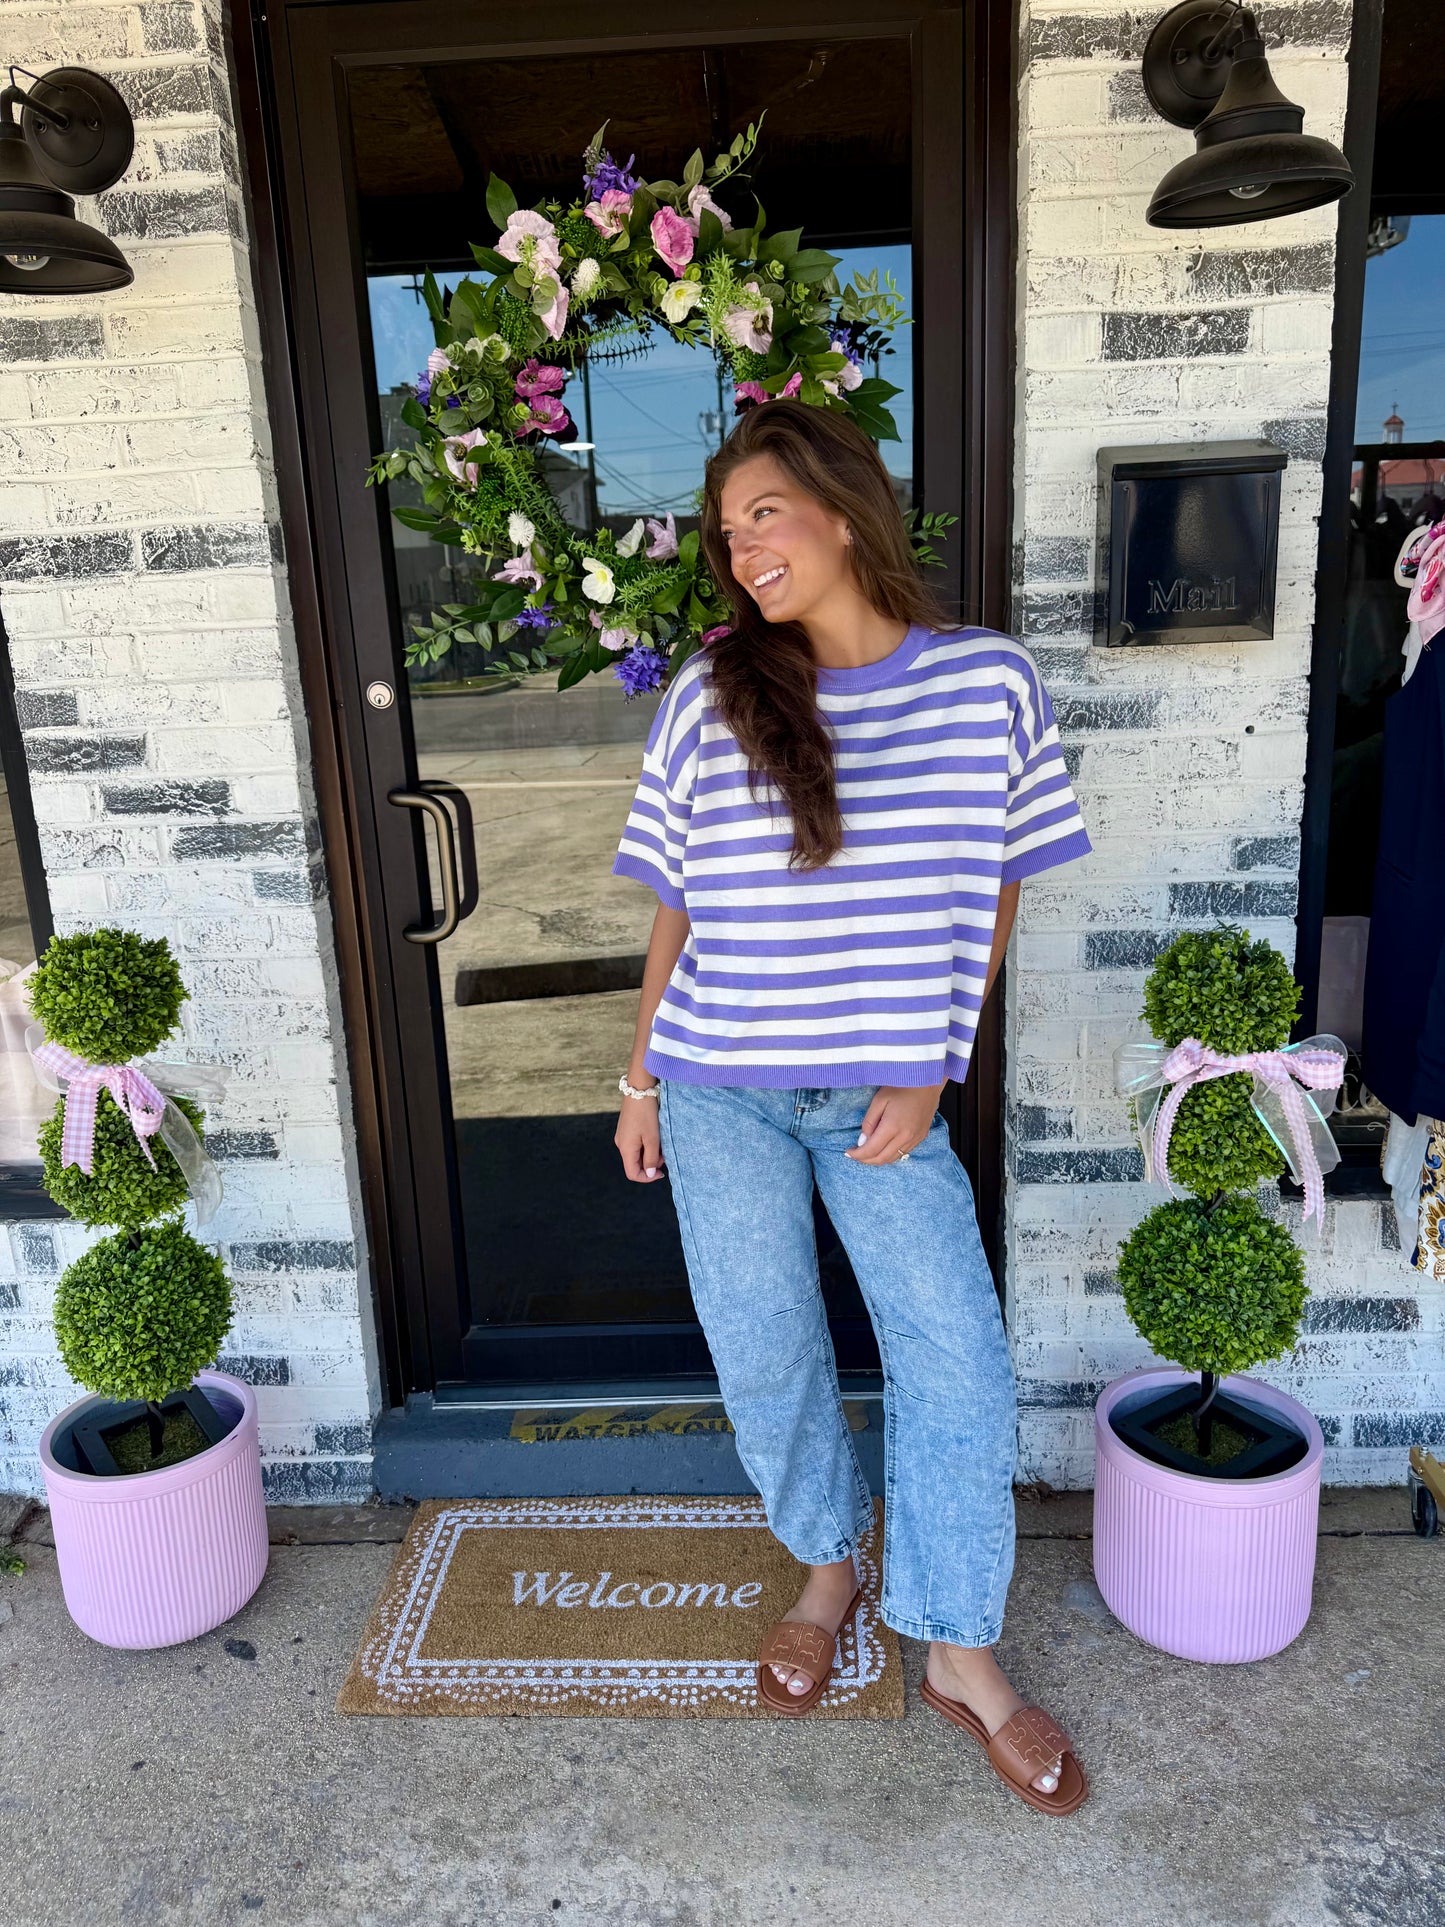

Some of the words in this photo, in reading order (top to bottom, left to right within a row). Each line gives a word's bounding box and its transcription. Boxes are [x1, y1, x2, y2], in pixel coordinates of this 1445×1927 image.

[1147, 577, 1238, 614] Mail
[535, 1422, 649, 1442] WATCH
[511, 1571, 764, 1608] Welcome
